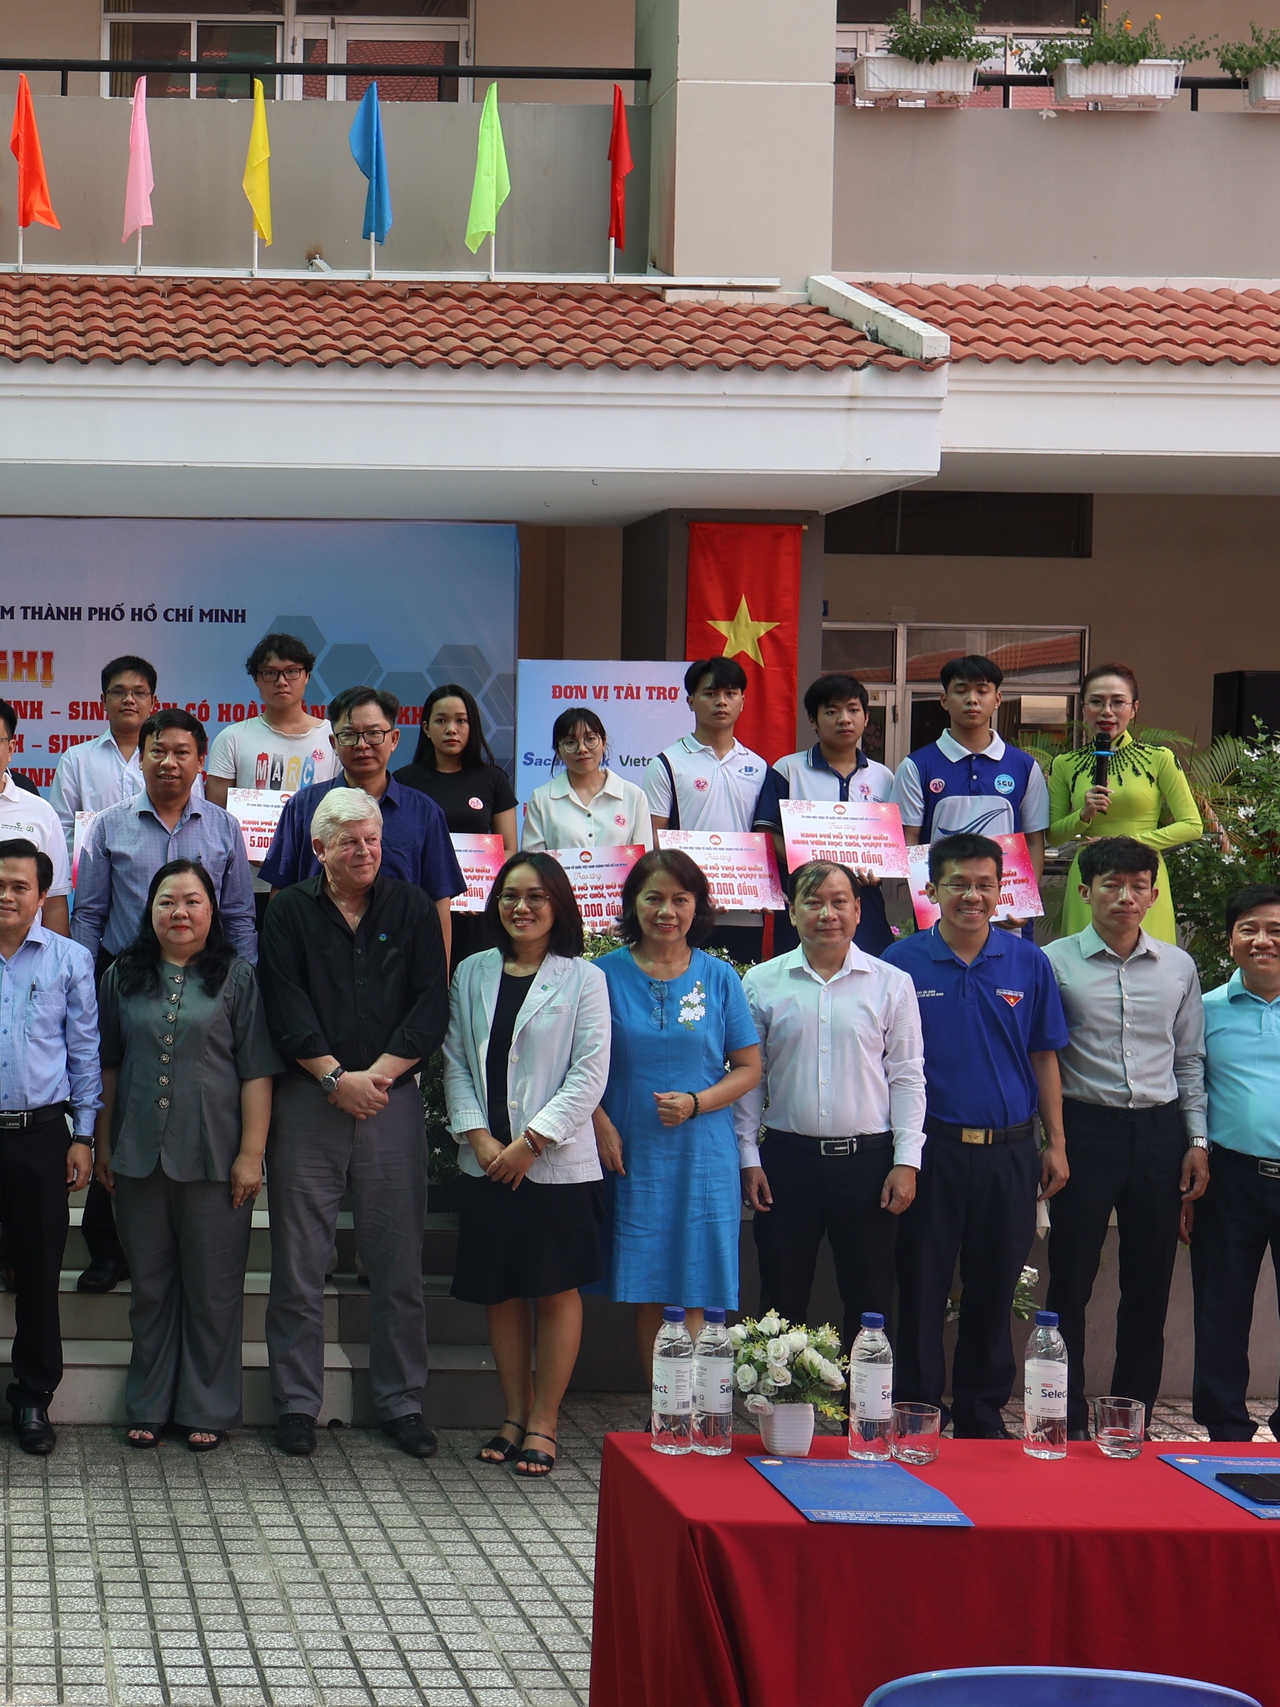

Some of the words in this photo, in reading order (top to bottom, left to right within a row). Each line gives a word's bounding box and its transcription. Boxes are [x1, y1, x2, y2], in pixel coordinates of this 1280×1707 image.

[20, 604, 83, 621] THÀNH
[88, 602, 126, 622] PHỐ
[130, 602, 158, 623] HỒ
[163, 605, 194, 623] CHÍ
[198, 608, 247, 623] MINH
[551, 685, 587, 700] ĐƠN
[592, 685, 608, 702] VỊ
[614, 682, 640, 700] TÀI
[646, 685, 680, 703] TRỢ
[185, 699, 210, 722] CÓ
[313, 750, 323, 760] 25
[256, 759, 314, 784] MARC
[696, 779, 707, 789] 22
[860, 785, 870, 793] 21
[616, 815, 626, 826] 23
[828, 840, 843, 848] HỌC
[862, 849, 884, 866] đồng
[590, 884, 604, 892] TRỢ
[738, 881, 759, 898] đồng
